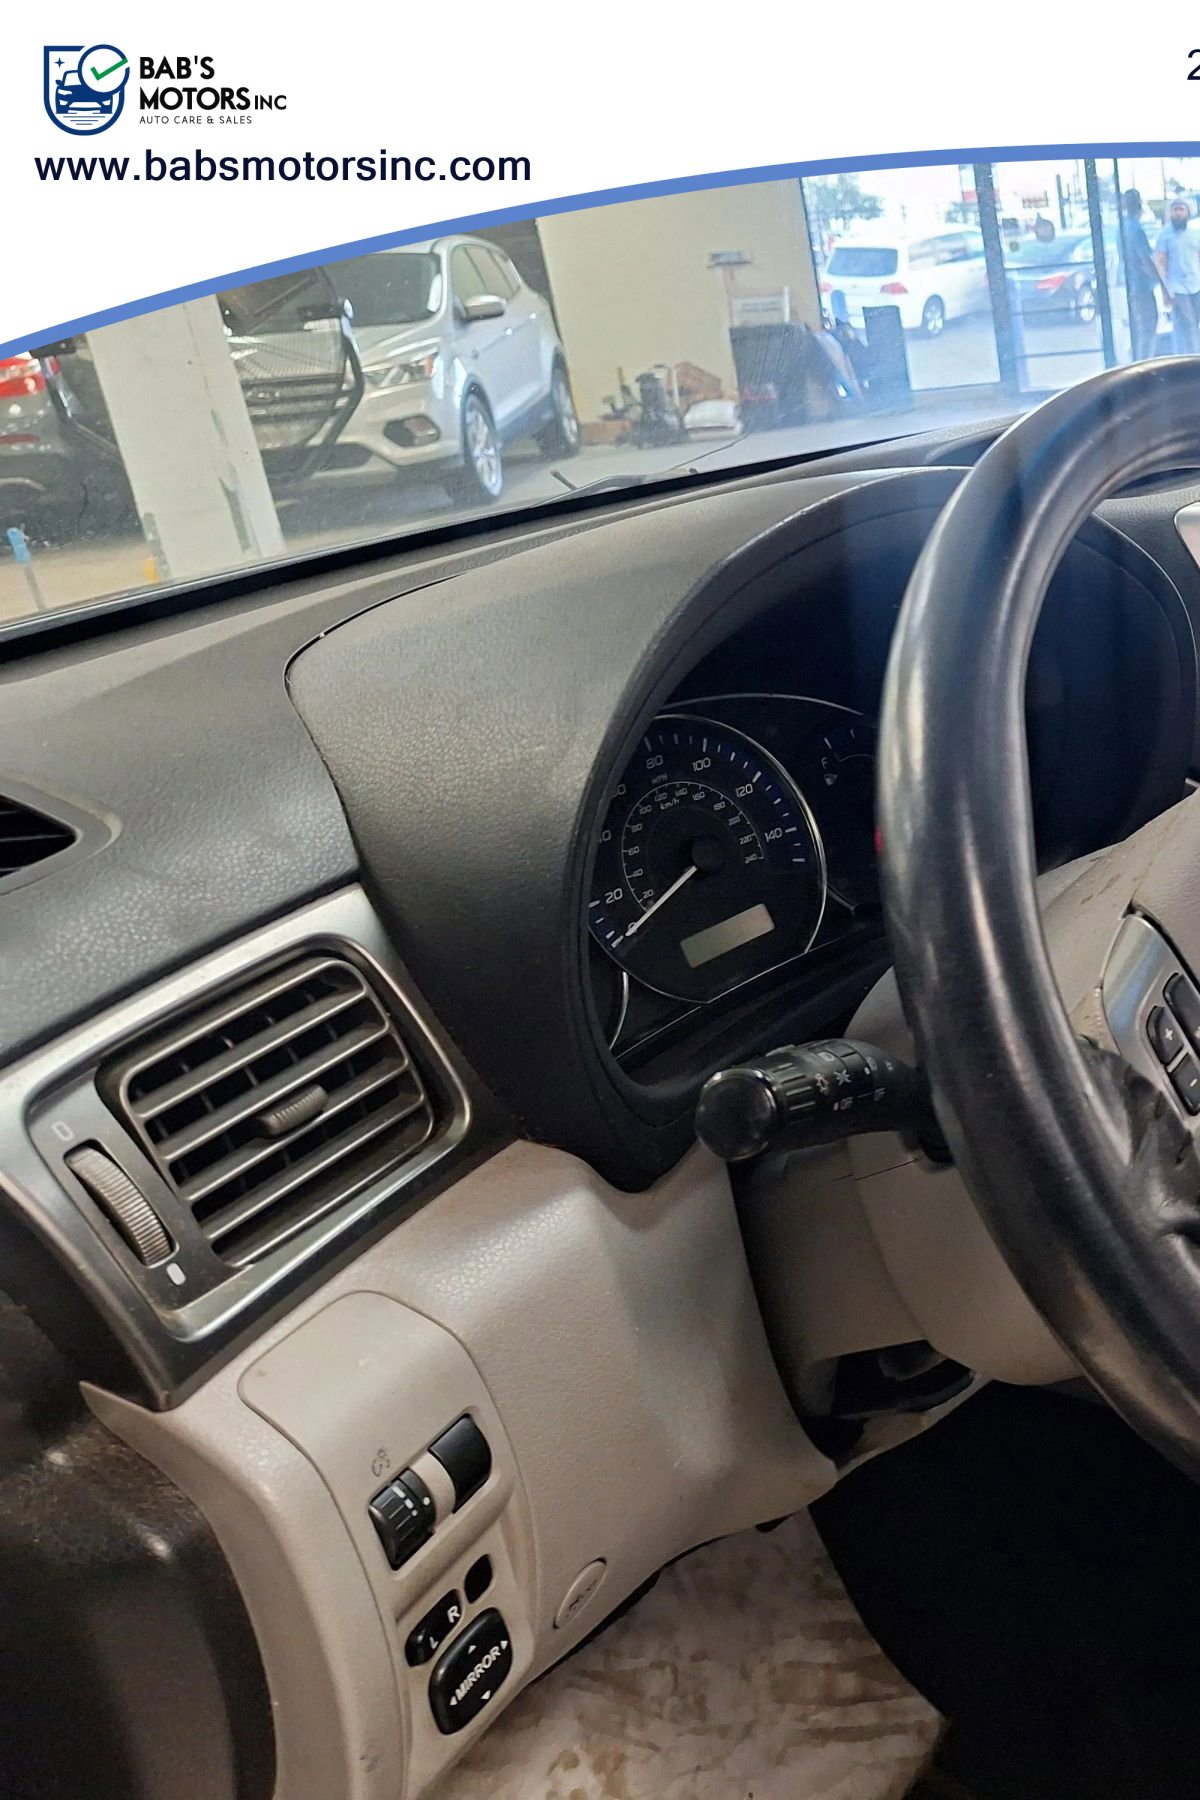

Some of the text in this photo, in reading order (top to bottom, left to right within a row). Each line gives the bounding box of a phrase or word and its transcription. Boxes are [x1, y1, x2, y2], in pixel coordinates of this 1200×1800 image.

[646, 754, 664, 769] 80
[692, 757, 711, 772] 100
[736, 783, 753, 798] 120
[764, 827, 783, 842] 140
[604, 888, 623, 904] 20
[447, 1605, 461, 1623] R
[429, 1636, 439, 1650] L
[455, 1645, 501, 1701] MIRROR
